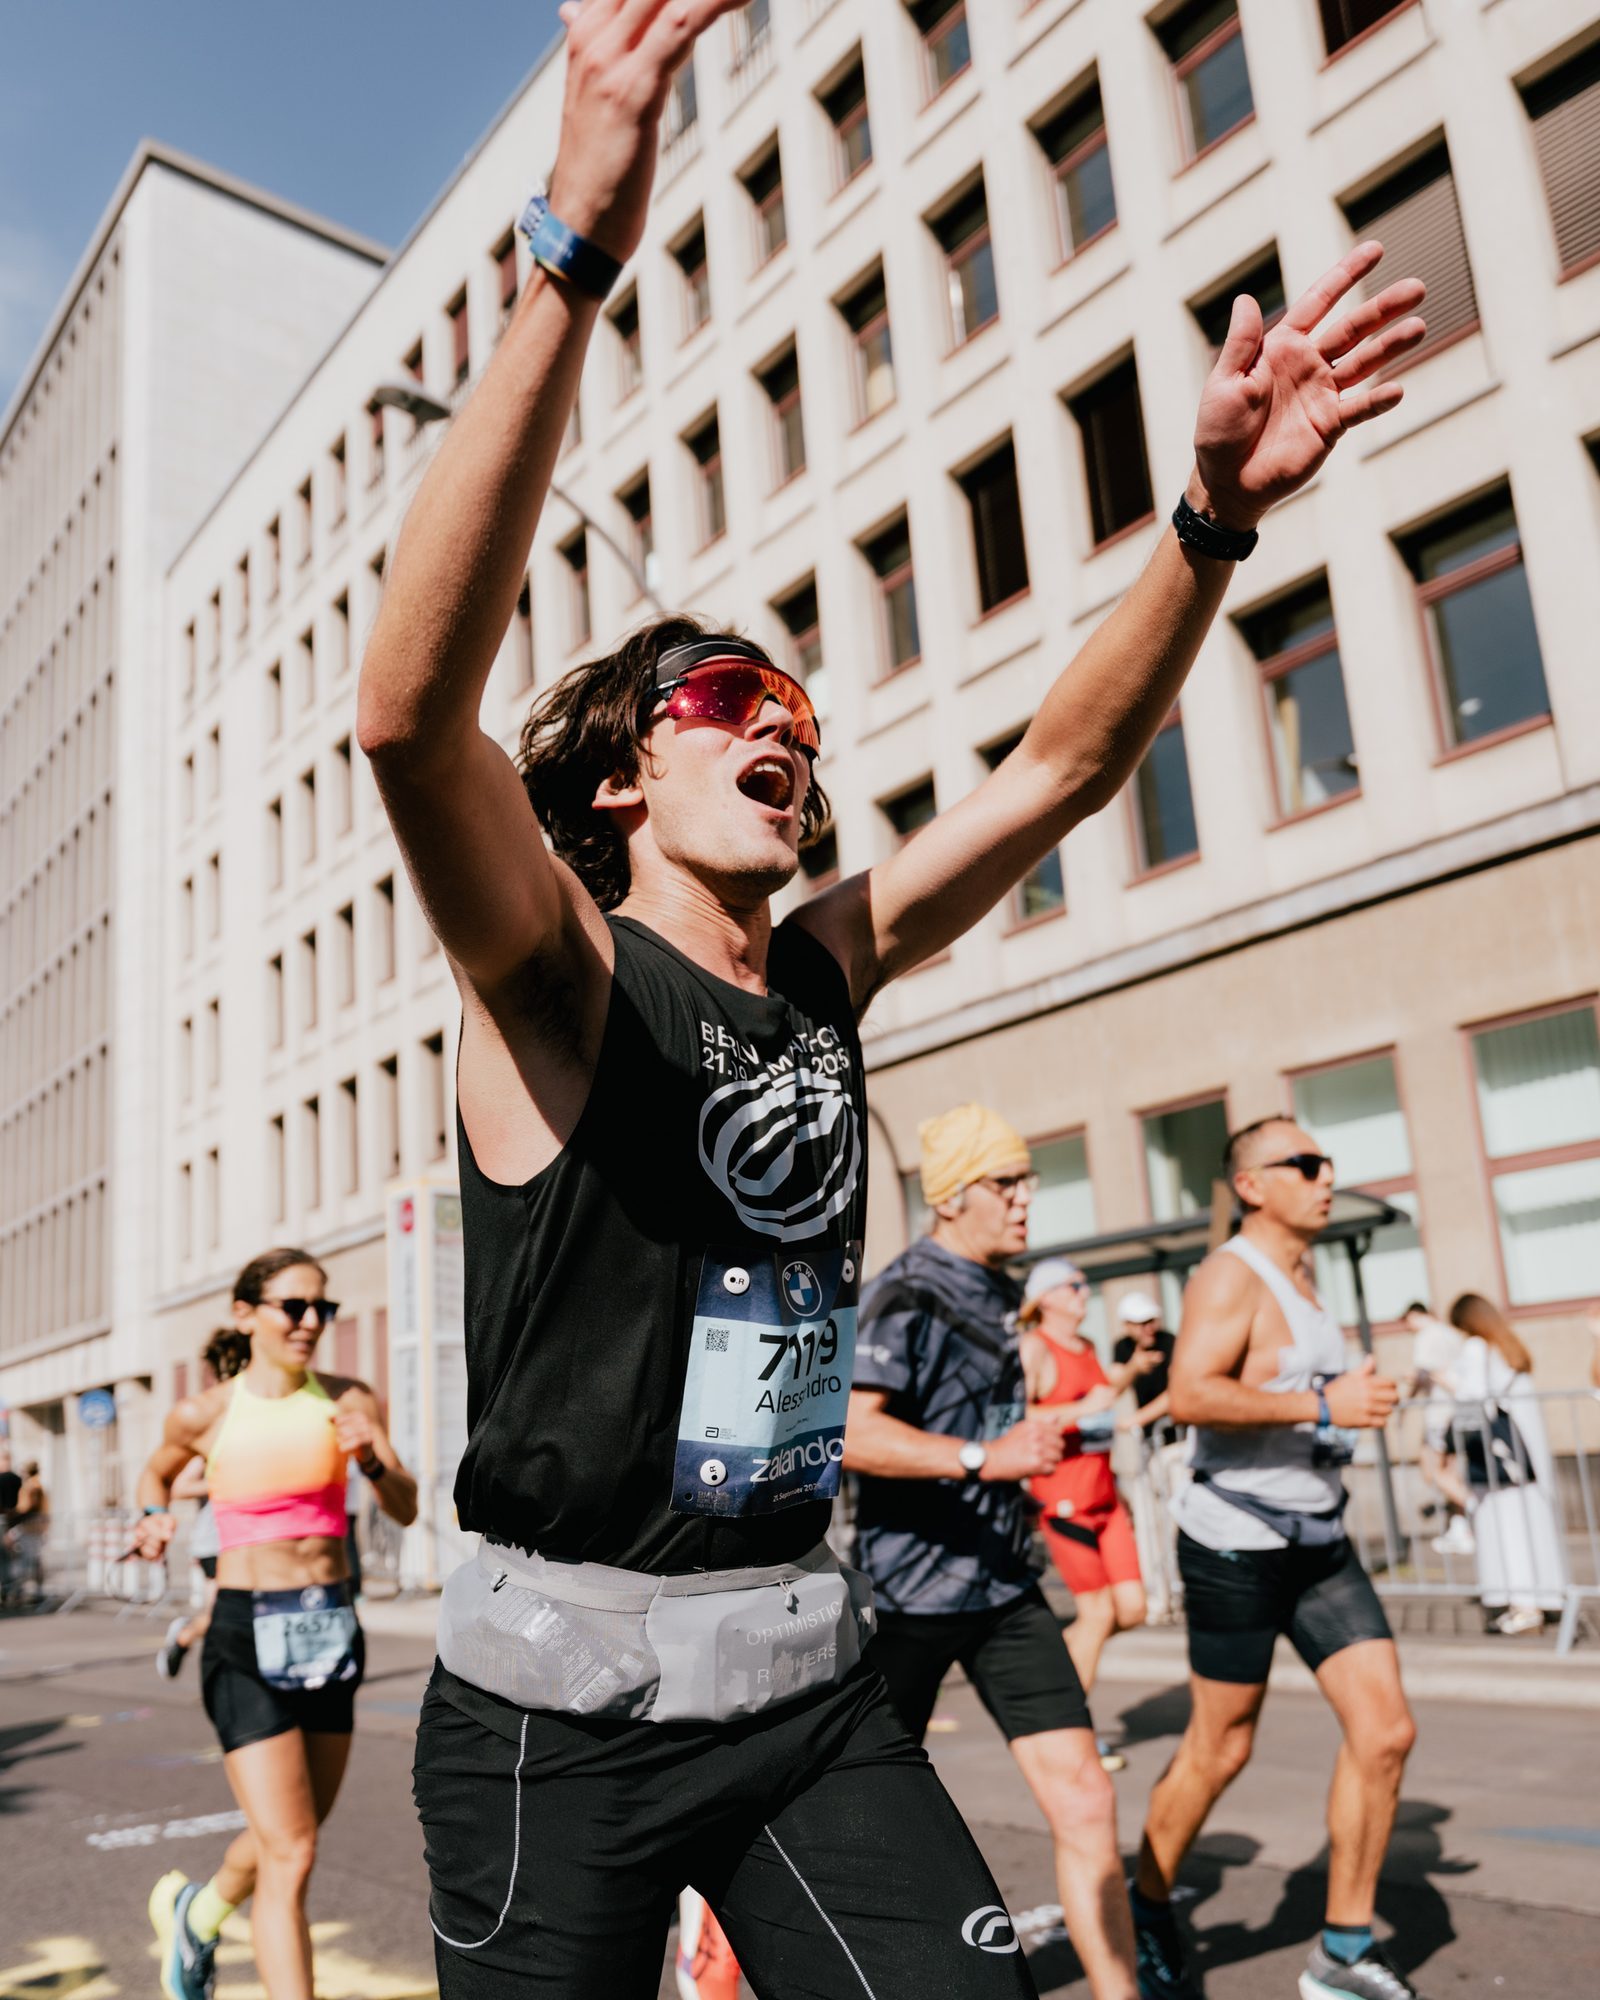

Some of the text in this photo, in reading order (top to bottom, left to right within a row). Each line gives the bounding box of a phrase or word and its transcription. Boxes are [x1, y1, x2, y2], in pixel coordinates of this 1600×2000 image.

[758, 1318, 838, 1381] 7119
[750, 1435, 844, 1482] zalando
[746, 1601, 841, 1646] OPTIMISTIC
